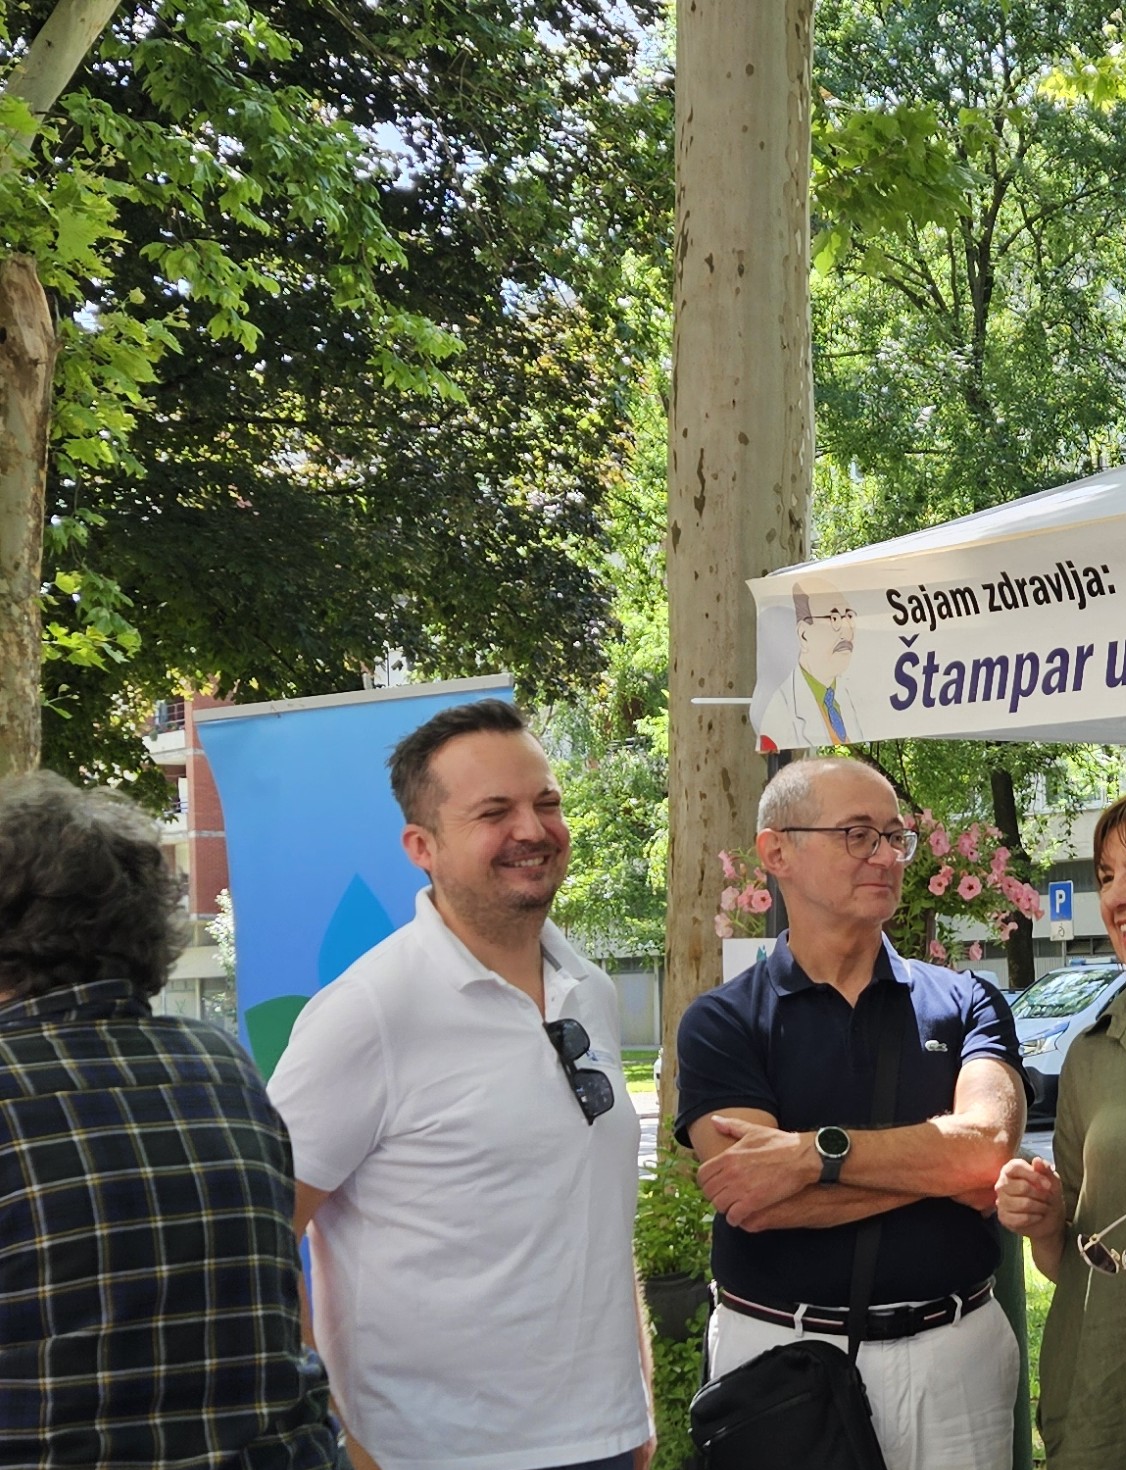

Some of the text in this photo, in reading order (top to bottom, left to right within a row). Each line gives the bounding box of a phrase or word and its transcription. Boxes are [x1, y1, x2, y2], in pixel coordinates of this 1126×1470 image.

[885, 560, 1116, 631] Sajam zdravlja:
[889, 633, 1095, 713] Štampar
[1055, 889, 1066, 914] P
